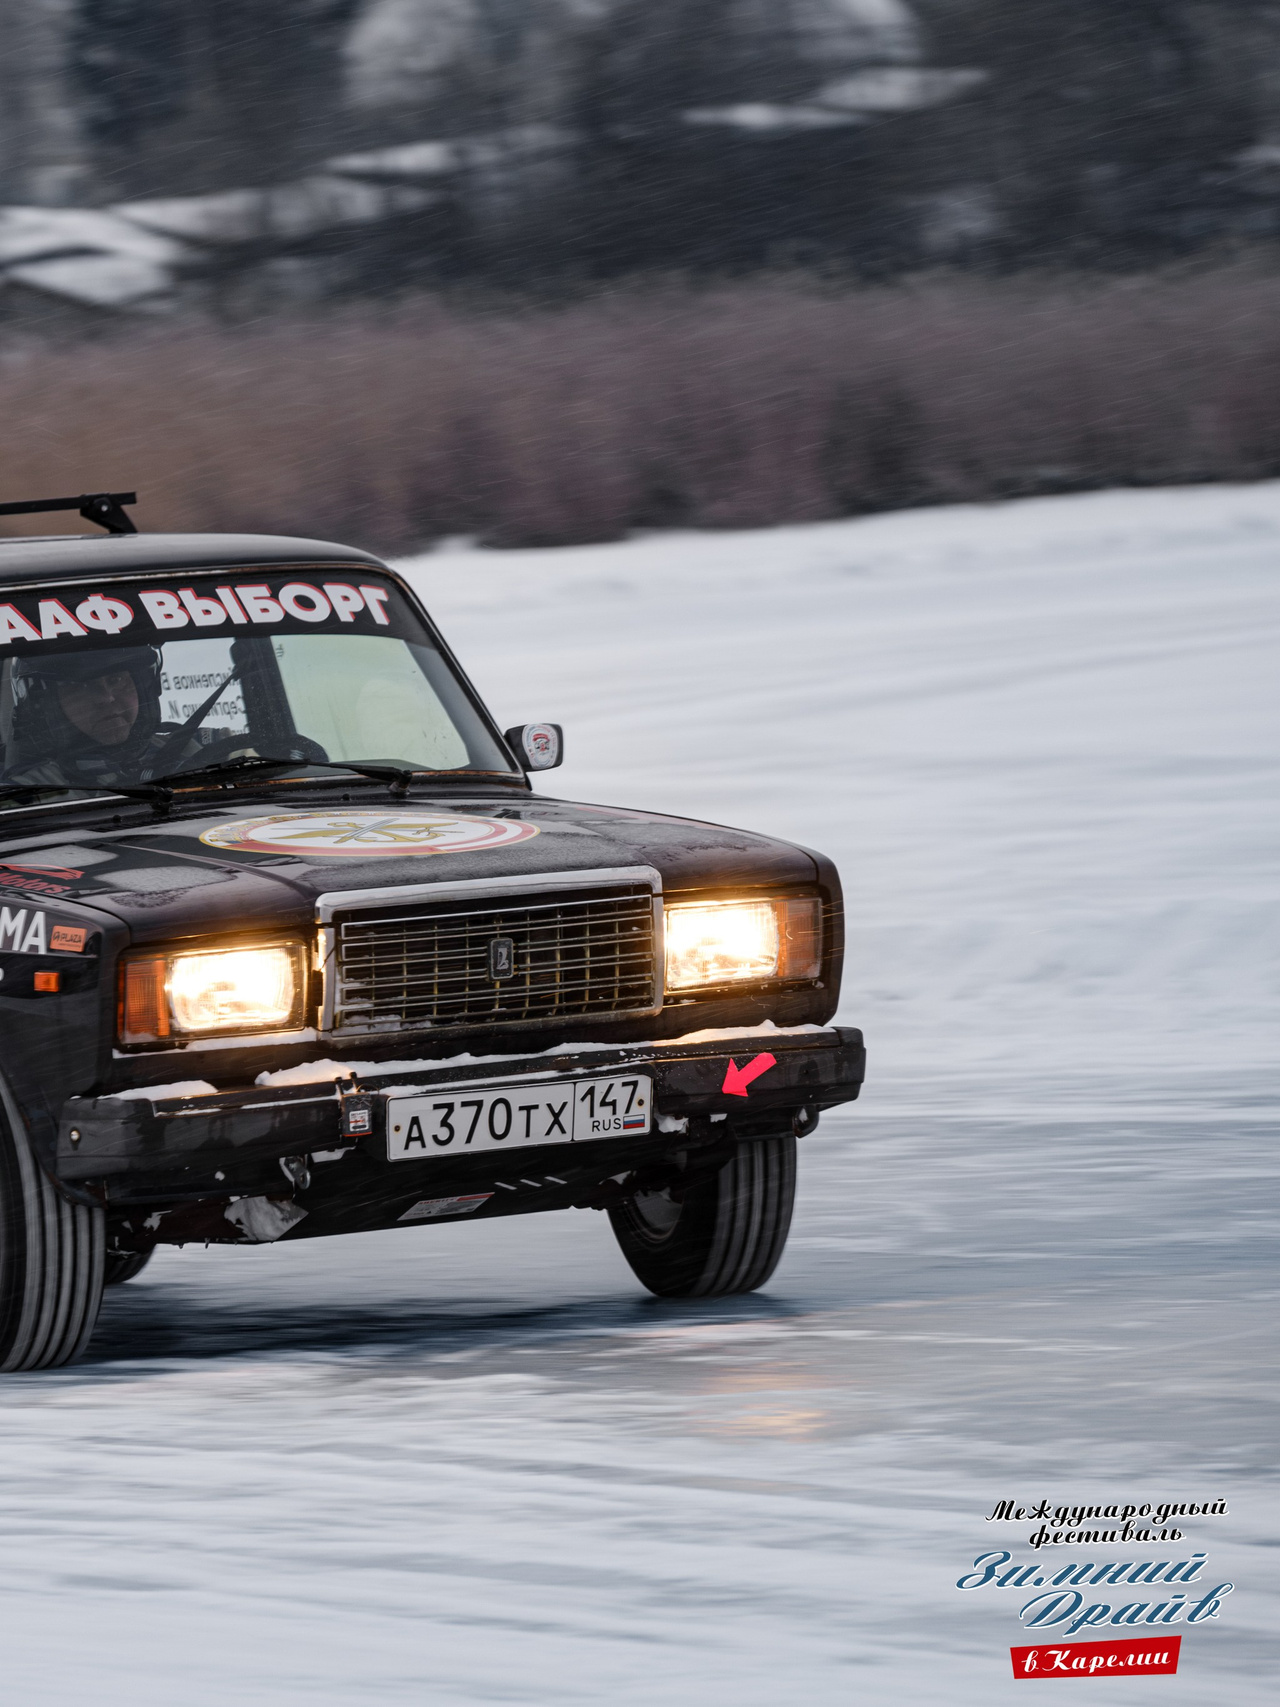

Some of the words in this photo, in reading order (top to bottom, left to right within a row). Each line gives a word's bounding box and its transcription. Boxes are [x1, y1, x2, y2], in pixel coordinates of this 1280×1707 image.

[138, 582, 390, 629] ВЫБОРГ
[403, 1097, 568, 1151] А370ТХ
[580, 1080, 639, 1118] 147
[591, 1117, 621, 1132] RUS
